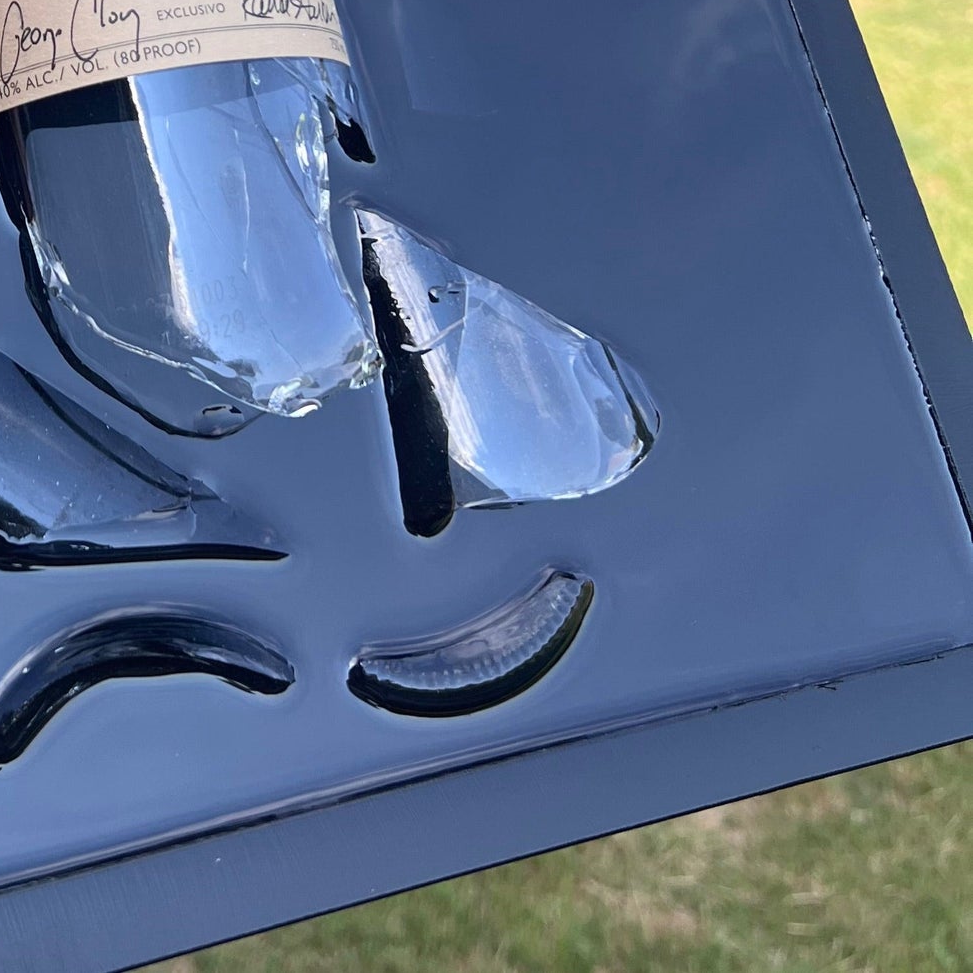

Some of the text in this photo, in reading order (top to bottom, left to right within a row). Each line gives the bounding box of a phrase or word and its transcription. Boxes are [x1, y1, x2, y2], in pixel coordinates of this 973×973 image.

[157, 2, 226, 21] EXCLUSIVO
[70, 60, 109, 77] VOL.
[144, 37, 202, 61] PROOF)
